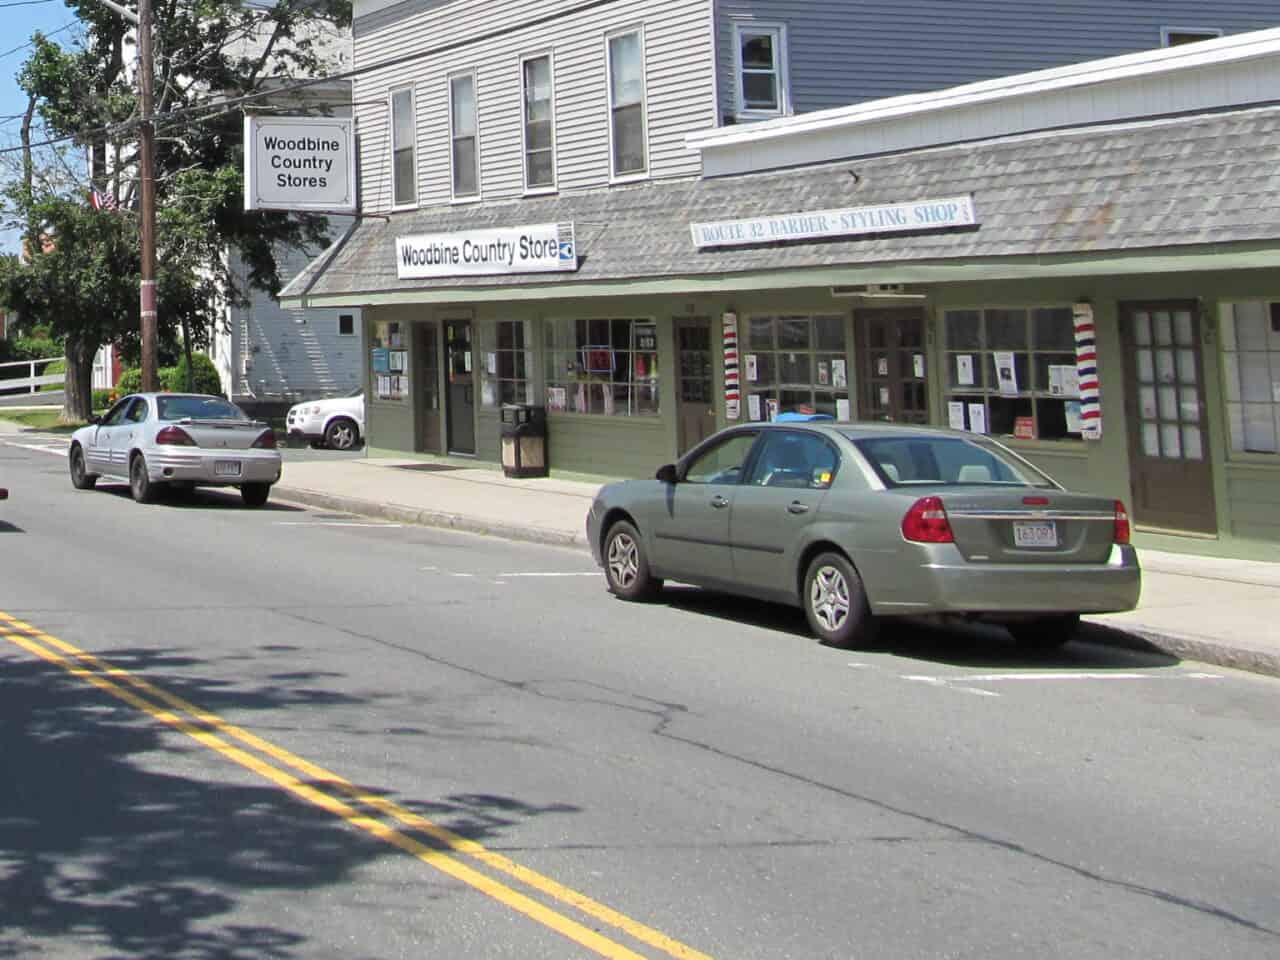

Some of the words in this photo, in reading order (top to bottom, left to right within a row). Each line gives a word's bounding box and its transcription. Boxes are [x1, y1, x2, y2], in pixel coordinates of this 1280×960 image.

[264, 136, 340, 152] Woodbine
[271, 154, 333, 172] Country
[276, 173, 327, 188] Stores
[914, 203, 958, 223] SHOP
[401, 246, 460, 267] Woodbine
[463, 240, 515, 267] Country
[519, 235, 558, 261] Store
